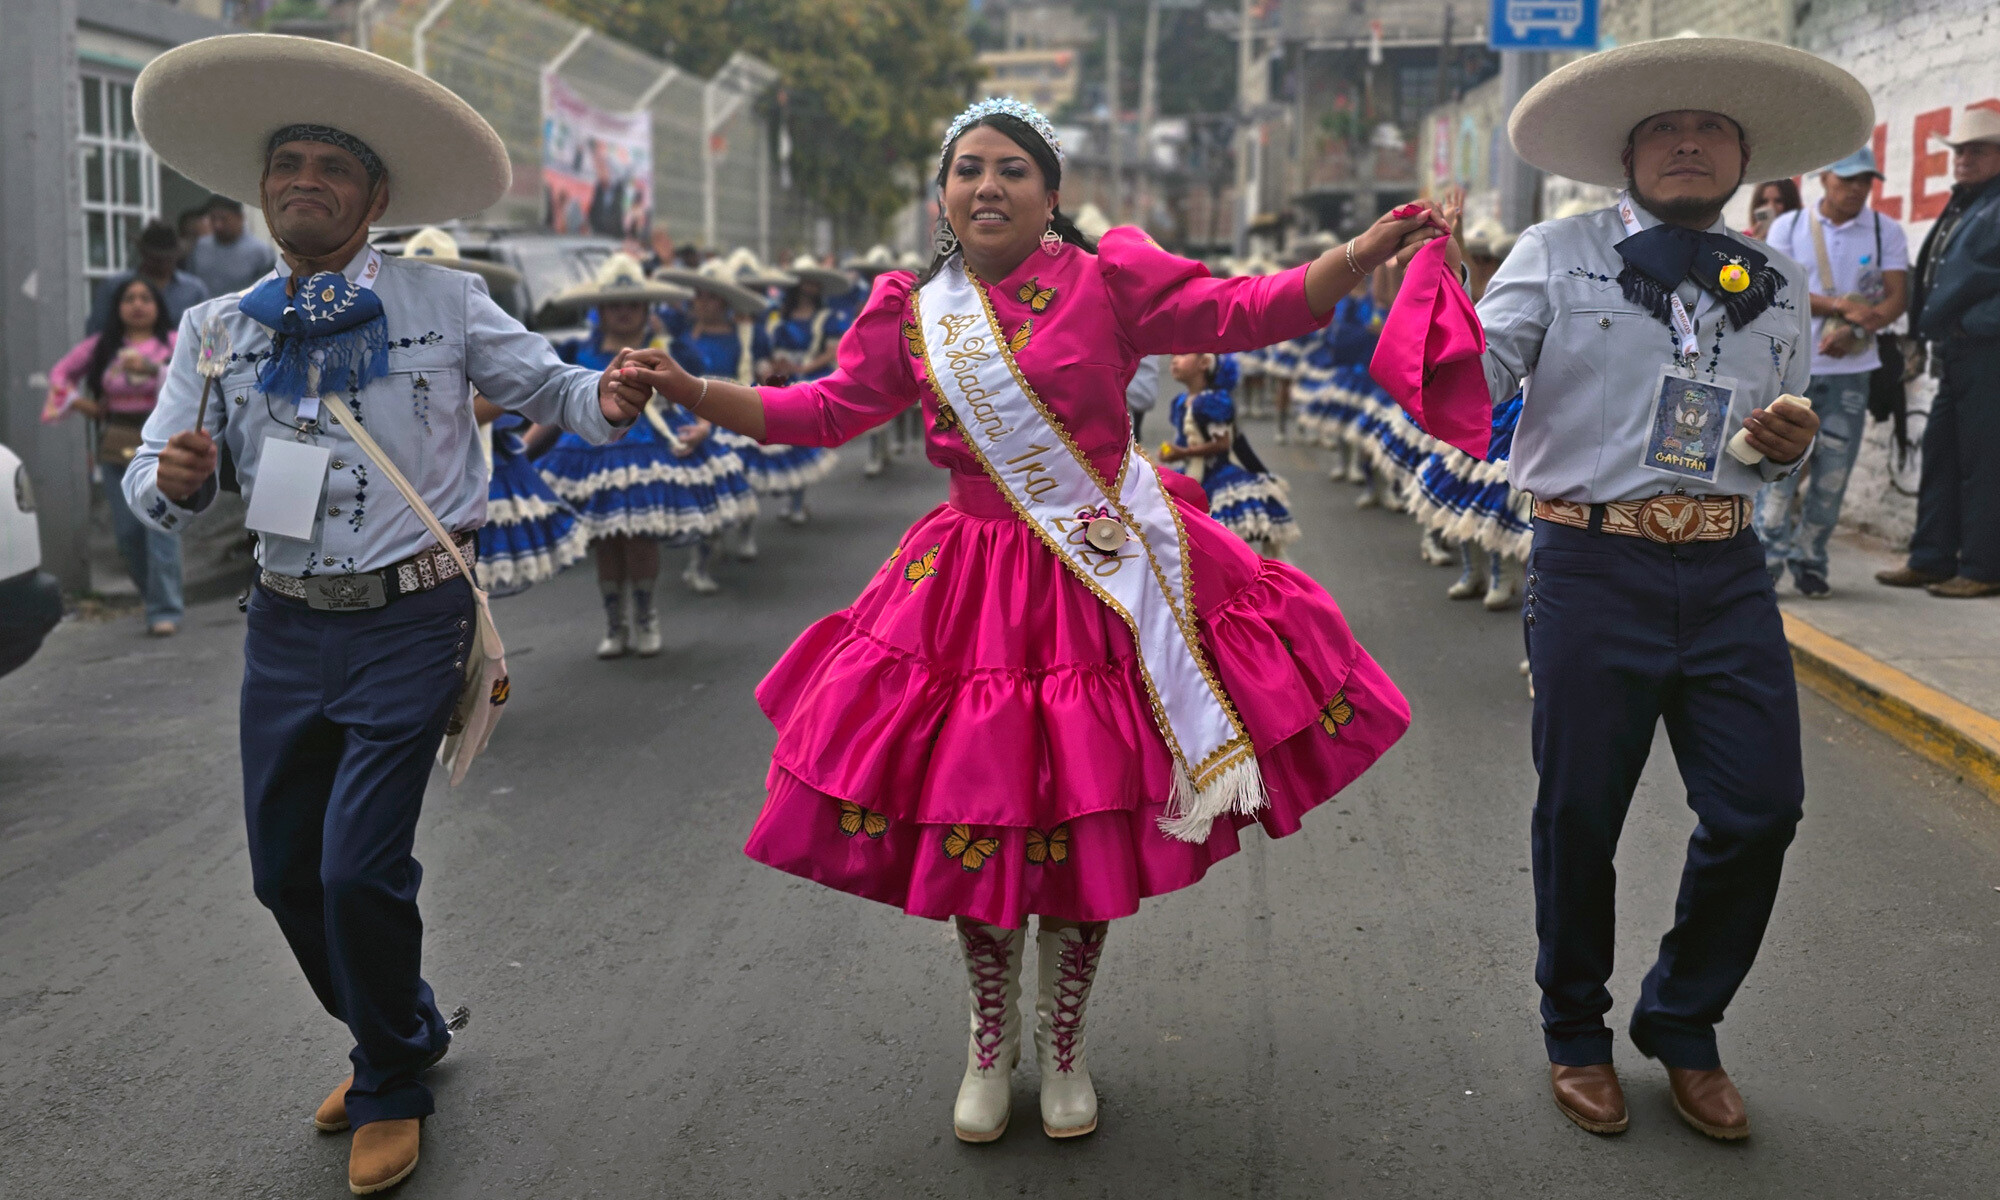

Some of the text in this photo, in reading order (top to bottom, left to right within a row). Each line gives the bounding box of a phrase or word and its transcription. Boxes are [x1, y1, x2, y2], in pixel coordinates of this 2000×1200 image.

[1671, 295, 1681, 309] LOS
[1677, 309, 1692, 335] AMIGOS
[1655, 452, 1707, 472] CAPITÁN
